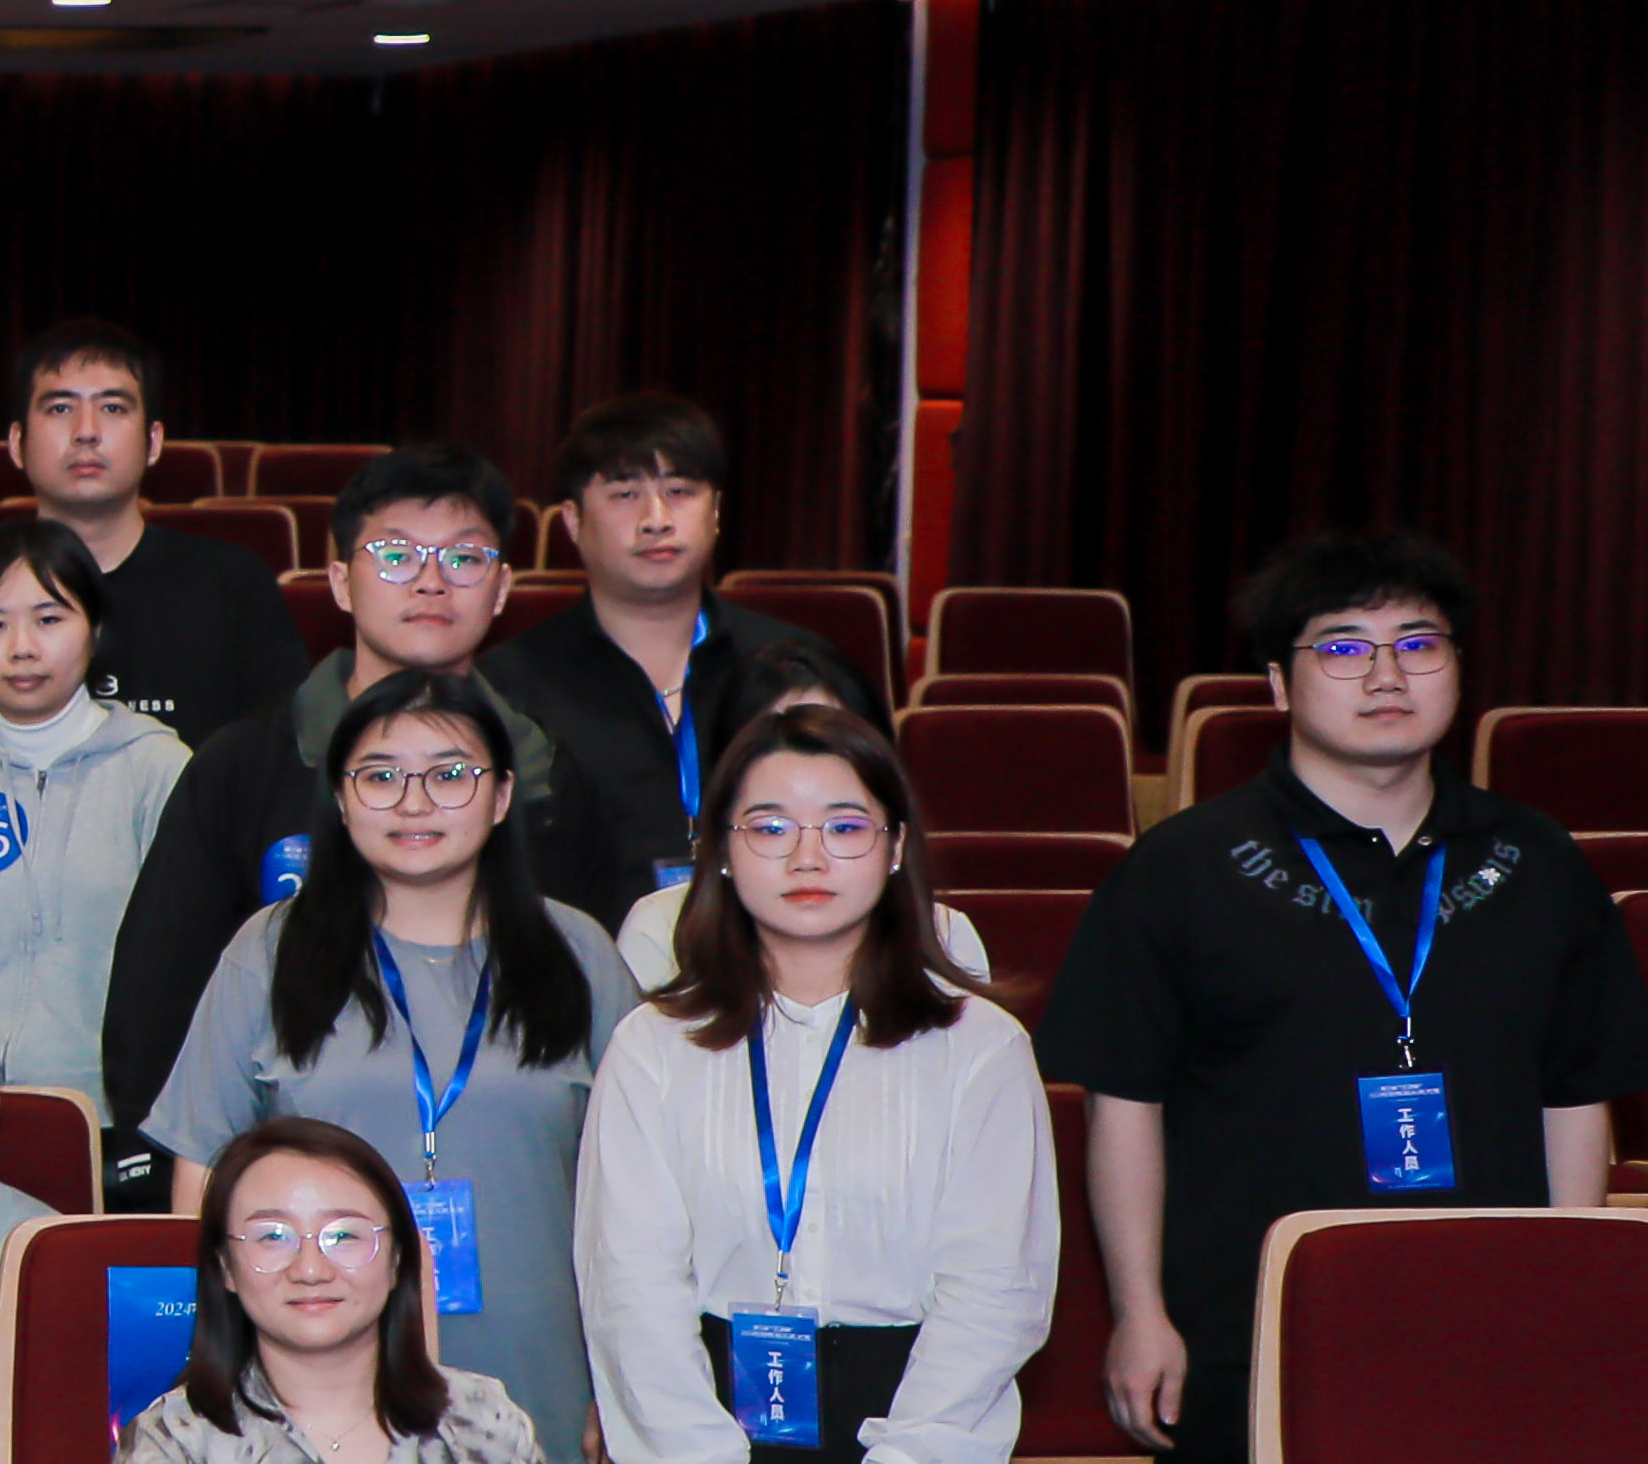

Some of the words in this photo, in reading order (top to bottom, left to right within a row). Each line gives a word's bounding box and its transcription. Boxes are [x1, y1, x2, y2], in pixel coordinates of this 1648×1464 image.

[1397, 1107, 1420, 1171] 工作人员
[766, 1350, 785, 1421] 工作人员
